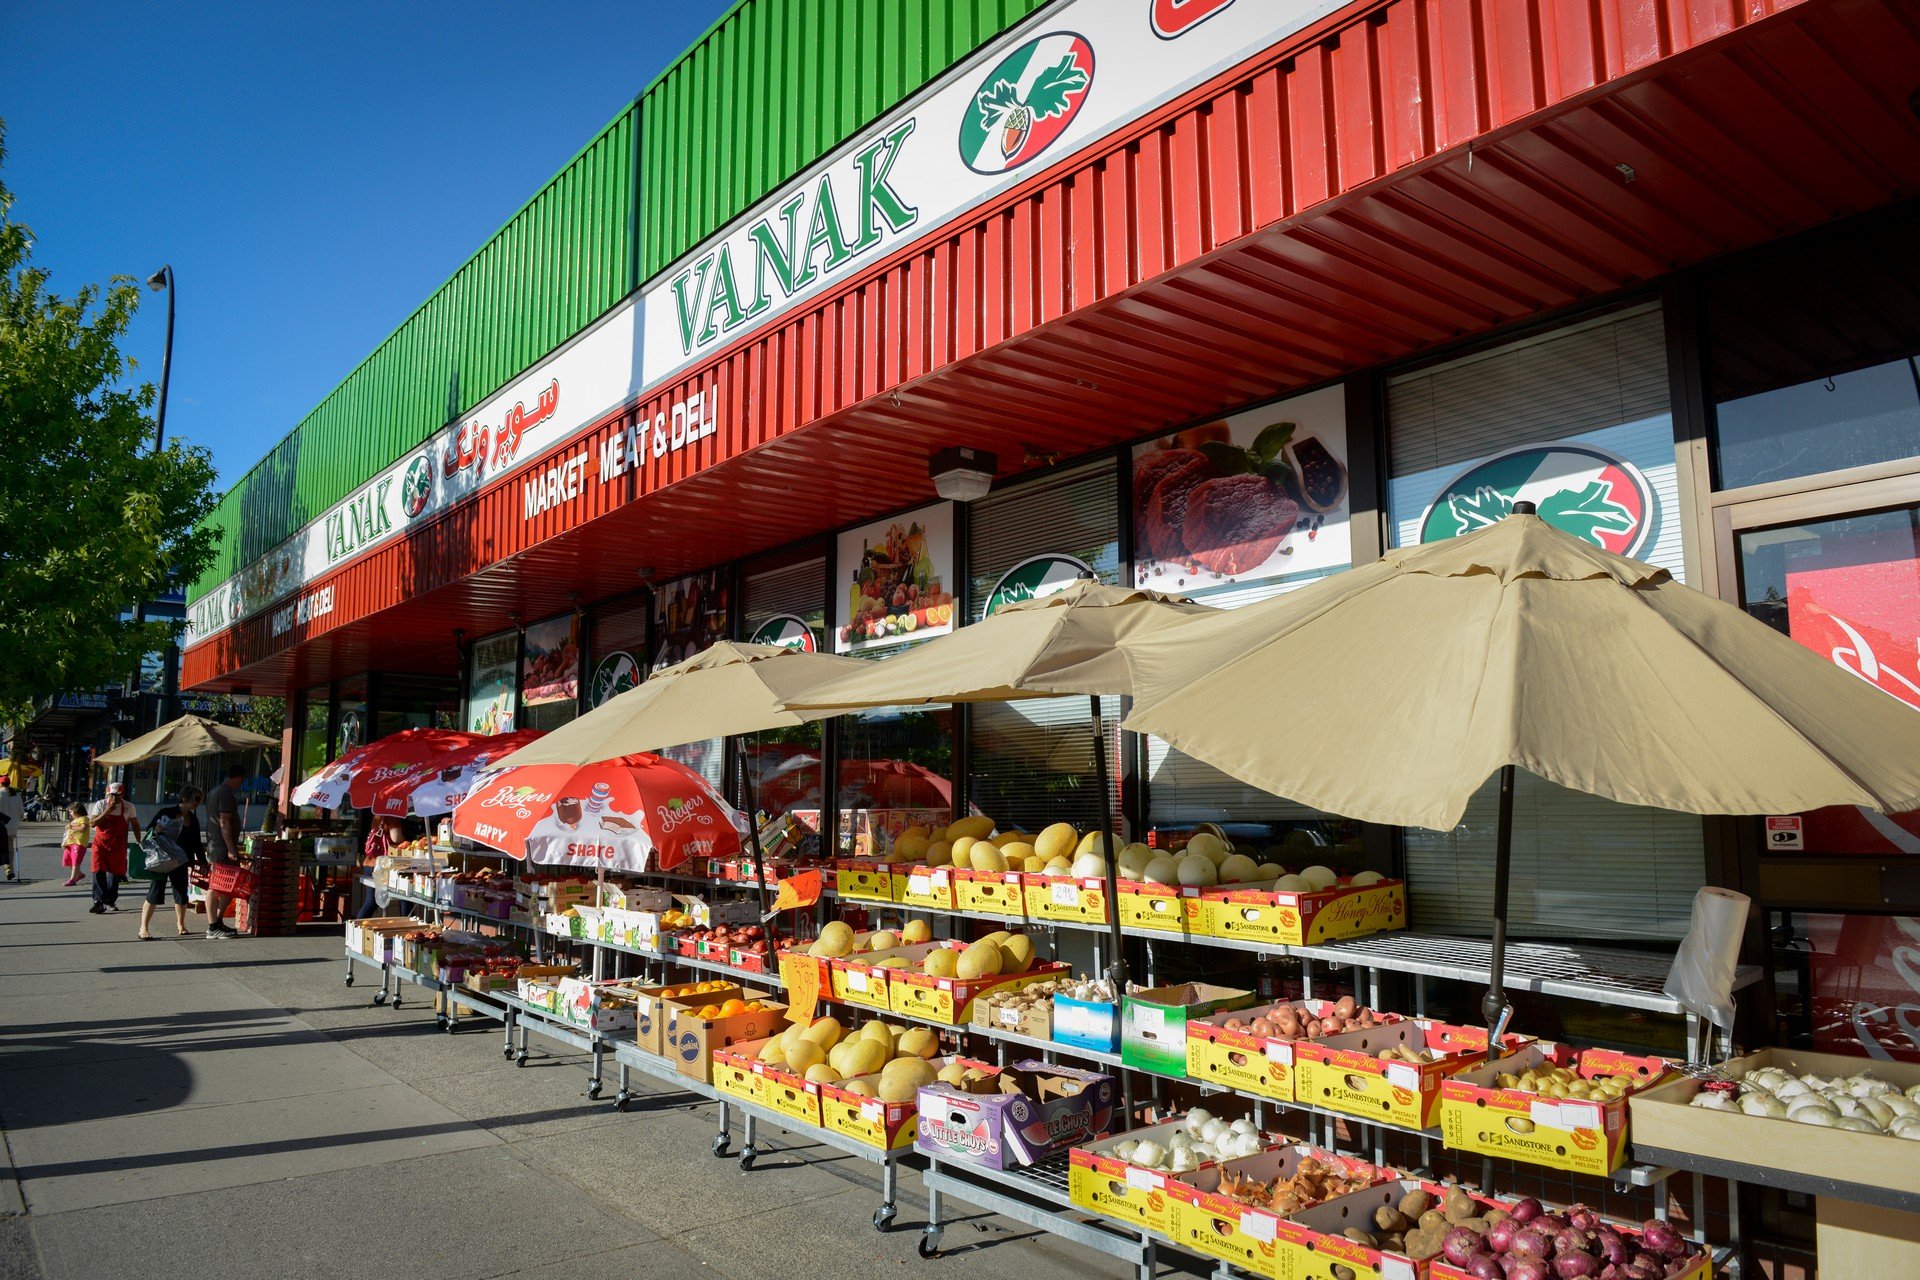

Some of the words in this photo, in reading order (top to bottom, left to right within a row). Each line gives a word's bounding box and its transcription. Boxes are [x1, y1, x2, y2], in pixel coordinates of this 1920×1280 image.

[671, 118, 918, 355] VANAK
[524, 452, 588, 520] MARKET
[600, 419, 650, 485] MEAT
[653, 412, 668, 458] &
[671, 384, 718, 452] DELI
[325, 475, 393, 564] VANAK
[196, 588, 226, 637] VANAK
[368, 762, 423, 784] Breyer
[481, 786, 553, 809] Breyers
[657, 795, 704, 833] Breyers
[1150, 912, 1176, 921] SANDSTONE
[1328, 899, 1367, 923] Honey
[1366, 893, 1391, 916] Kiss
[1240, 922, 1270, 933] SANDSTONE
[1217, 1030, 1240, 1047] Honey
[1239, 1034, 1257, 1048] Kiss
[1450, 1032, 1477, 1047] Honey
[1332, 1051, 1358, 1068] Honey
[1358, 1057, 1378, 1070] Kiss
[1581, 1056, 1612, 1072] Honey
[1227, 1066, 1259, 1082] SANDSTONE
[1343, 1089, 1382, 1106] SANDSTONE
[1490, 1090, 1527, 1110] Honey
[1061, 1109, 1090, 1135] CHUYS
[1392, 1109, 1418, 1119] SPECIALTY
[1395, 1116, 1415, 1125] MELONS
[930, 1122, 958, 1143] LITTLE
[960, 1130, 987, 1152] CHUYS
[1504, 1134, 1554, 1153] SANDSTONE
[1099, 1157, 1121, 1176] Honey
[1570, 1154, 1604, 1165] SPECIALTY
[1575, 1160, 1600, 1171] MELONS
[1108, 1195, 1139, 1212] SANDSTONE
[1202, 1195, 1229, 1215] Honey
[1210, 1235, 1246, 1256] SANDSTONE
[1316, 1235, 1347, 1257] Honey
[1346, 1245, 1369, 1263] Kiss
